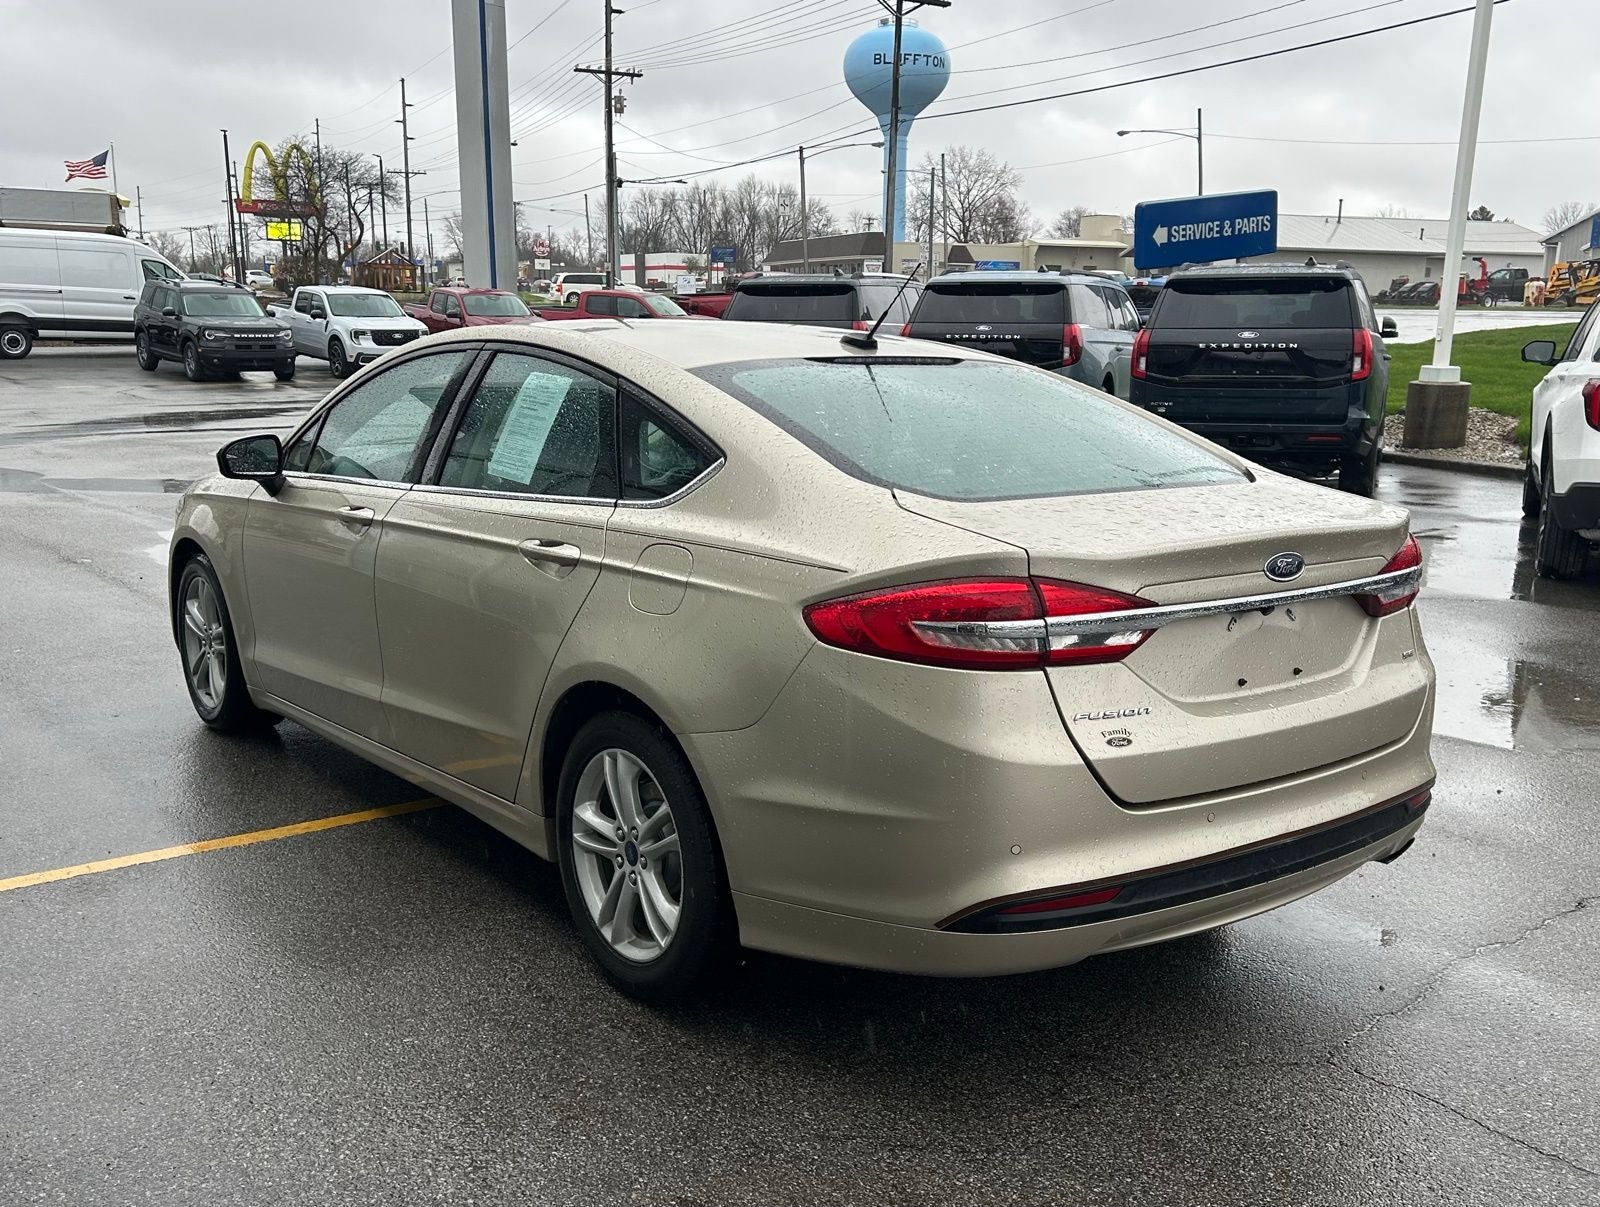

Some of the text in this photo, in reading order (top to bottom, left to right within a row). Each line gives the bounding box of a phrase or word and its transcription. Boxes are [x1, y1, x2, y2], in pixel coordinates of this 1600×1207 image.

[1171, 215, 1271, 243] SERVICE & PARTS
[1275, 558, 1299, 575] Ford
[1072, 707, 1152, 721] FUSION
[1100, 727, 1132, 738] Family
[1110, 738, 1129, 747] Ford
